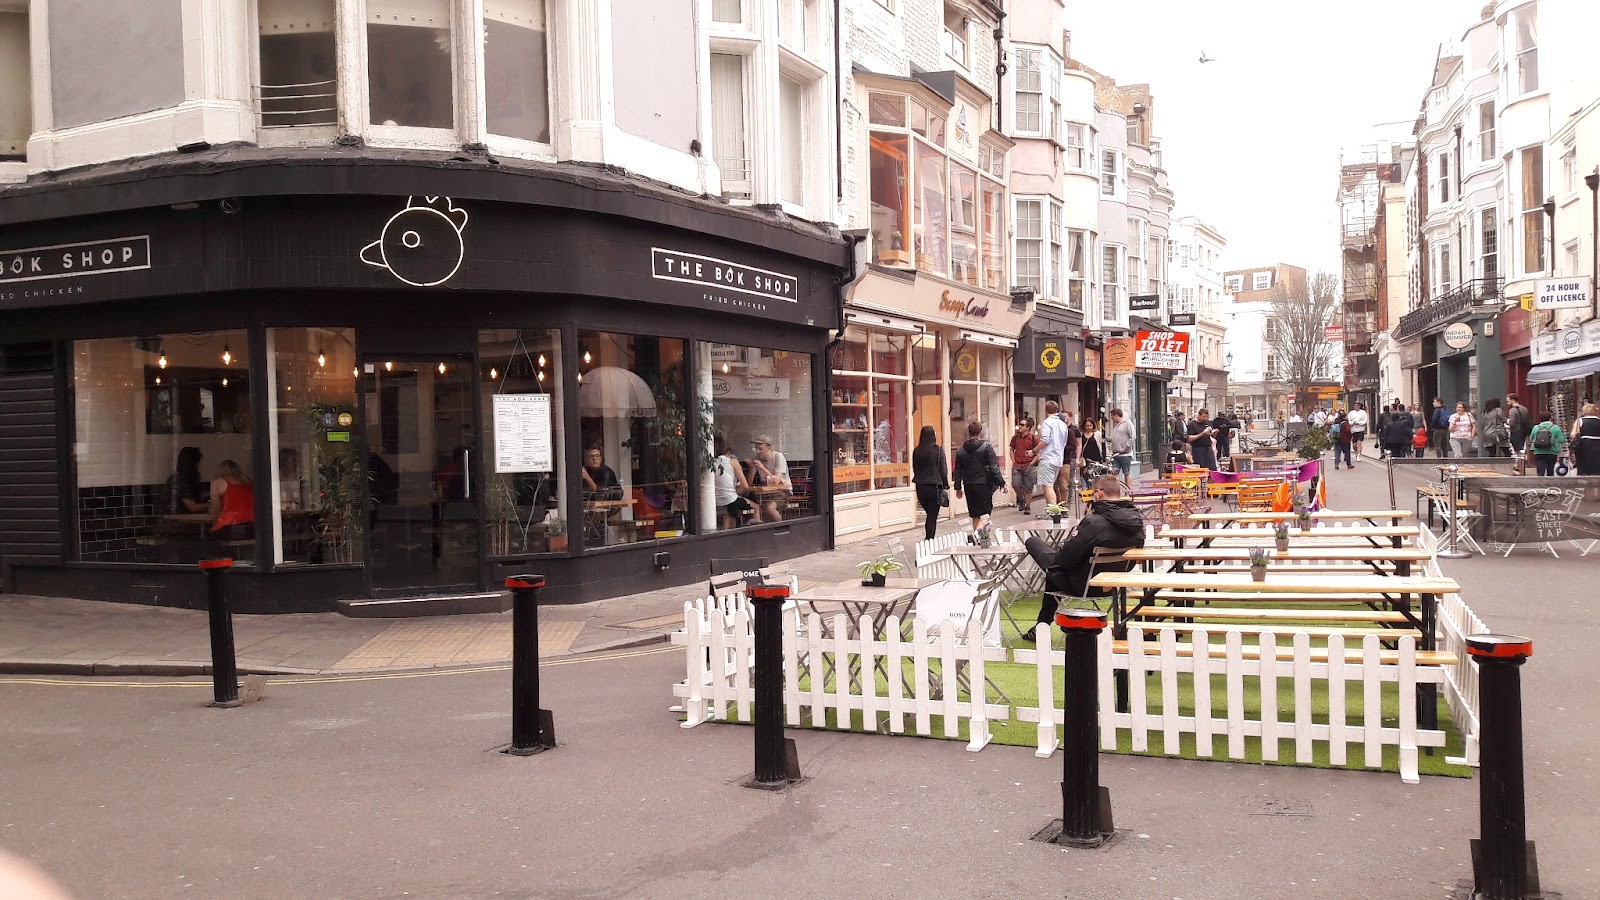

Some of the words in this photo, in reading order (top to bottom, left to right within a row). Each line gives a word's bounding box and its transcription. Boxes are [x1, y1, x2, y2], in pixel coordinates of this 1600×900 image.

[62, 246, 133, 269] SHOP
[664, 258, 703, 278] THE
[715, 266, 745, 286] BOK
[755, 275, 790, 295] SHOP
[24, 286, 83, 298] CHICKEN
[1546, 284, 1556, 292] 24
[1558, 283, 1580, 291] HOUR
[703, 294, 728, 304] FRIED
[733, 299, 767, 311] CHICKEN
[1541, 295, 1554, 303] OFF
[1557, 293, 1586, 302] LICENCE
[1147, 331, 1175, 340] SHOP
[1140, 339, 1157, 351] TO
[1158, 340, 1184, 352] LET
[1535, 512, 1562, 522] EAST
[1536, 521, 1562, 529] STREET
[1538, 529, 1562, 538] TAP
